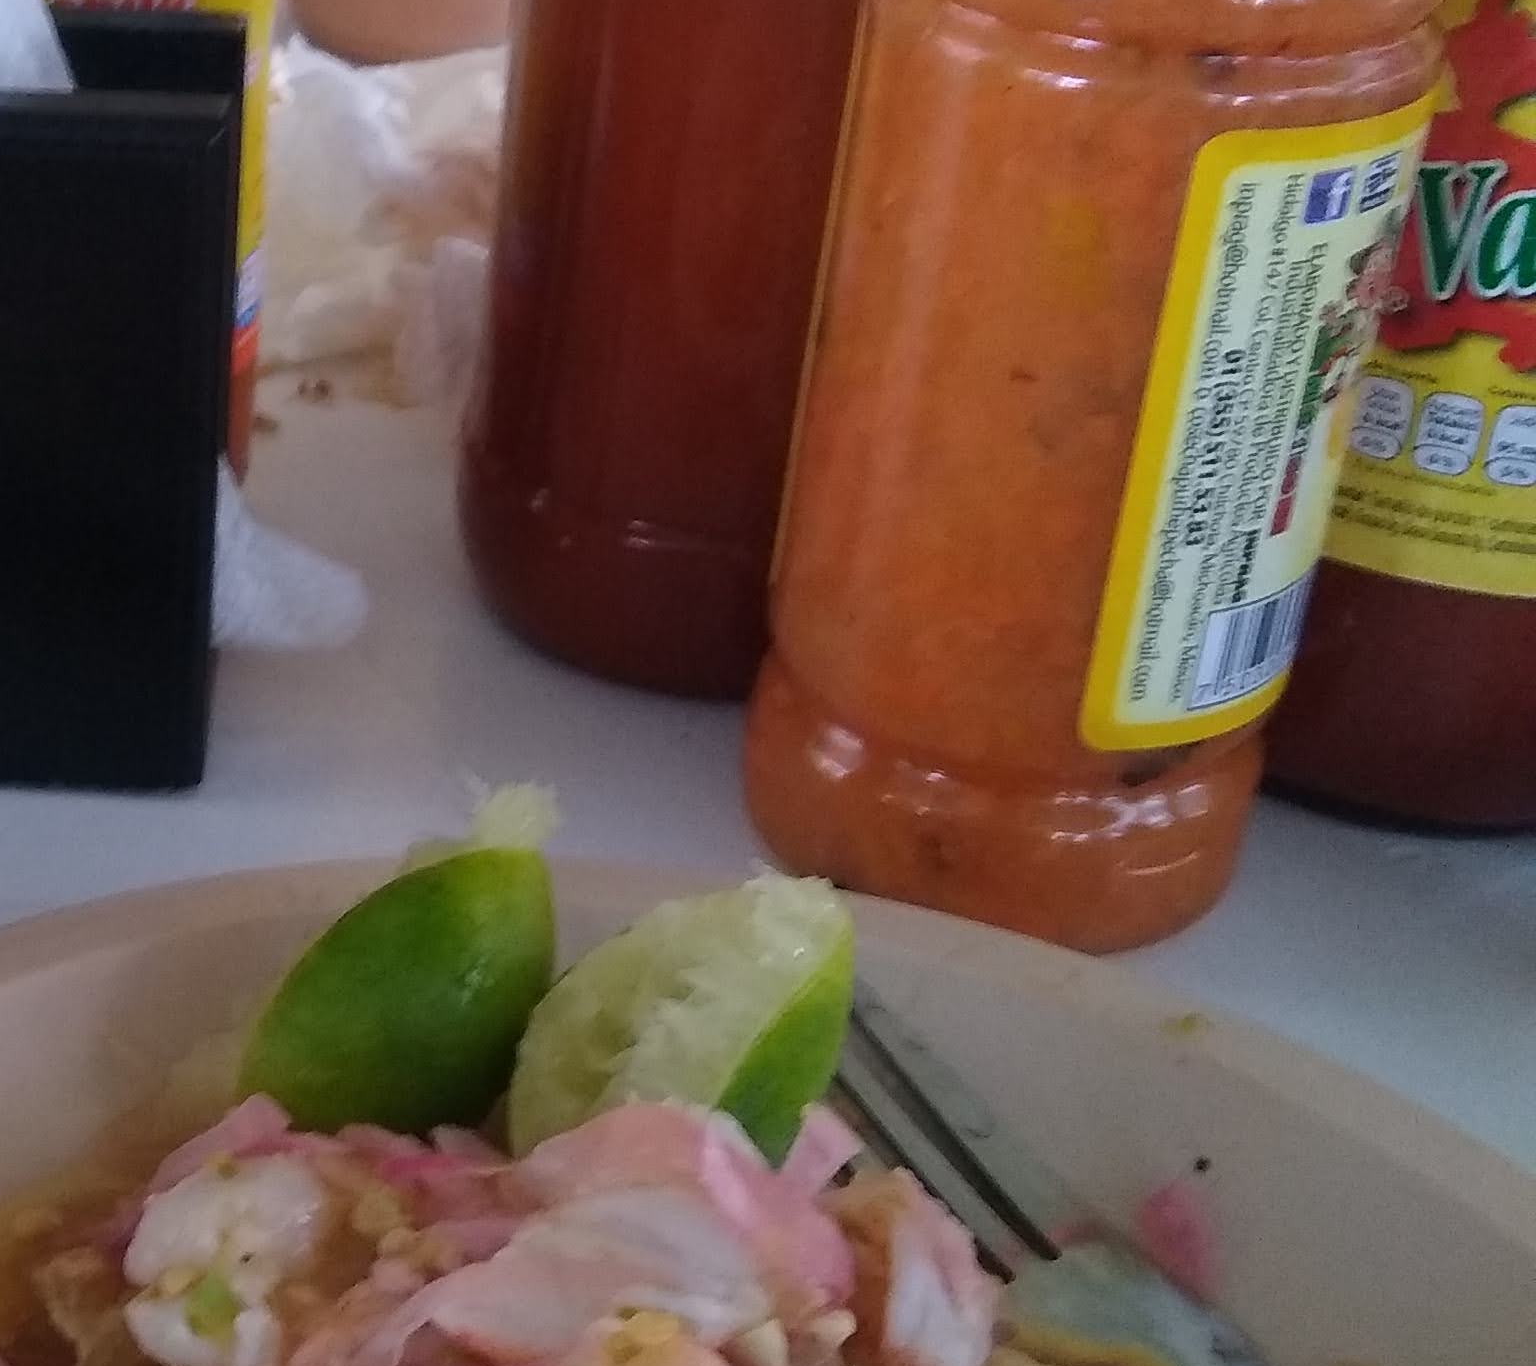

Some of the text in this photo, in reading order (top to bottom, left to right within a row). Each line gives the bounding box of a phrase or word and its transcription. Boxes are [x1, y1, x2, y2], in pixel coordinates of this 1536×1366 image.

[1268, 172, 1306, 244] Hidalgo
[1288, 242, 1329, 353] ELABORADO
[1220, 347, 1248, 375] 01
[1260, 369, 1299, 481] DISTRIBUIDO
